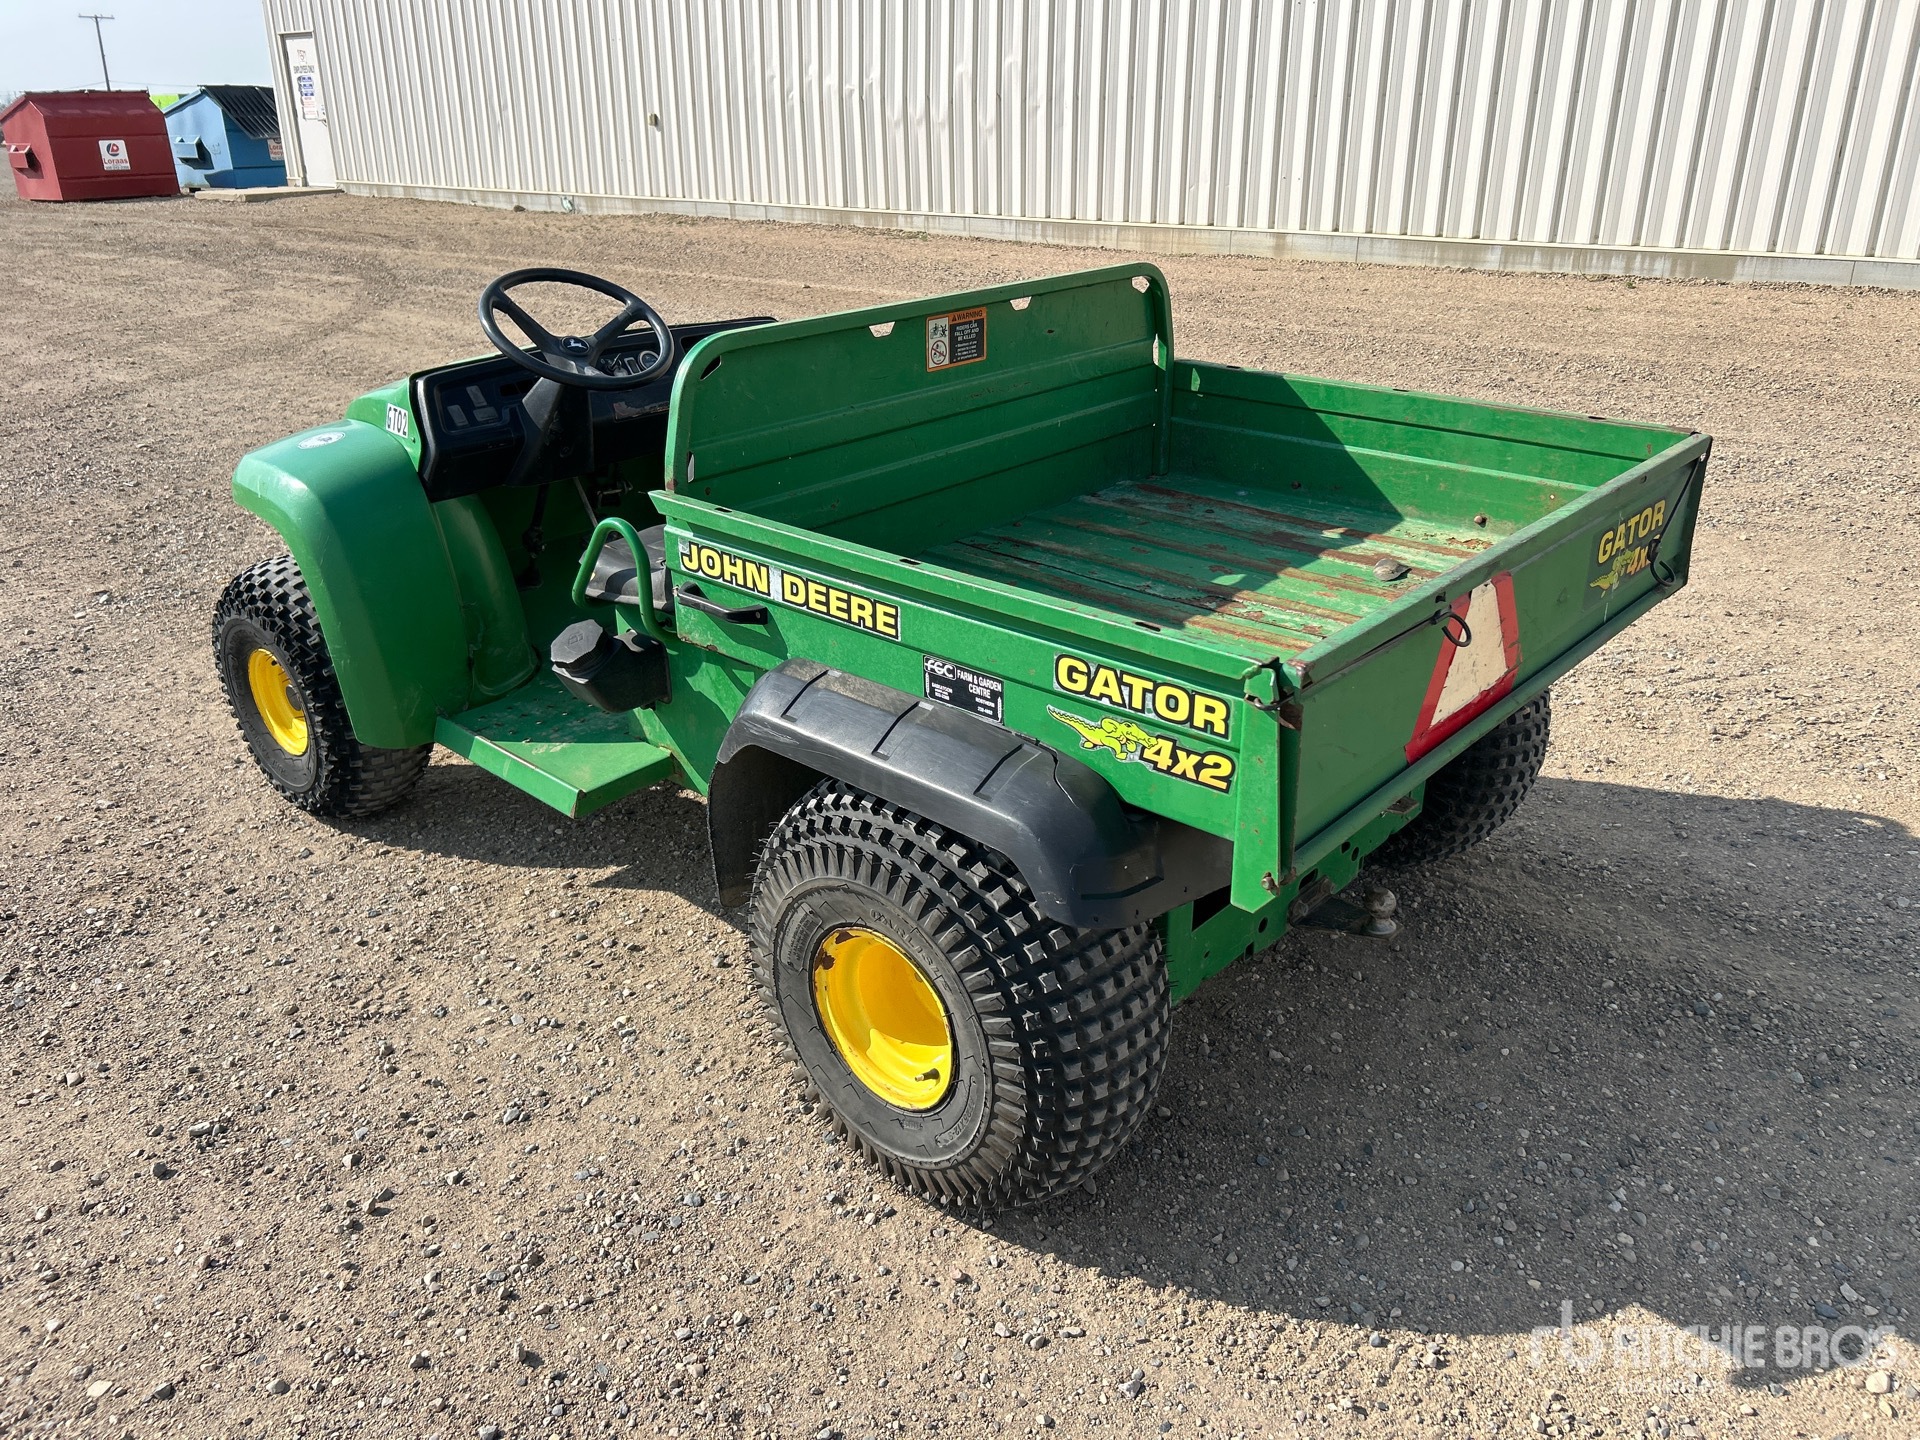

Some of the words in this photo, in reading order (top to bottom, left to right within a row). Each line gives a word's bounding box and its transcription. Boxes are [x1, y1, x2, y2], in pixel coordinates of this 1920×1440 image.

[957, 309, 983, 320] WARNING
[1598, 499, 1666, 564] GATOR
[682, 542, 770, 595] JOHN
[782, 572, 898, 638] DEERE
[957, 669, 973, 683] FARM
[973, 675, 979, 685] &
[978, 677, 1002, 692] GARDEN
[968, 683, 991, 699] CENTRE
[1056, 655, 1229, 739] GATOR
[1141, 735, 1235, 792] 4x2
